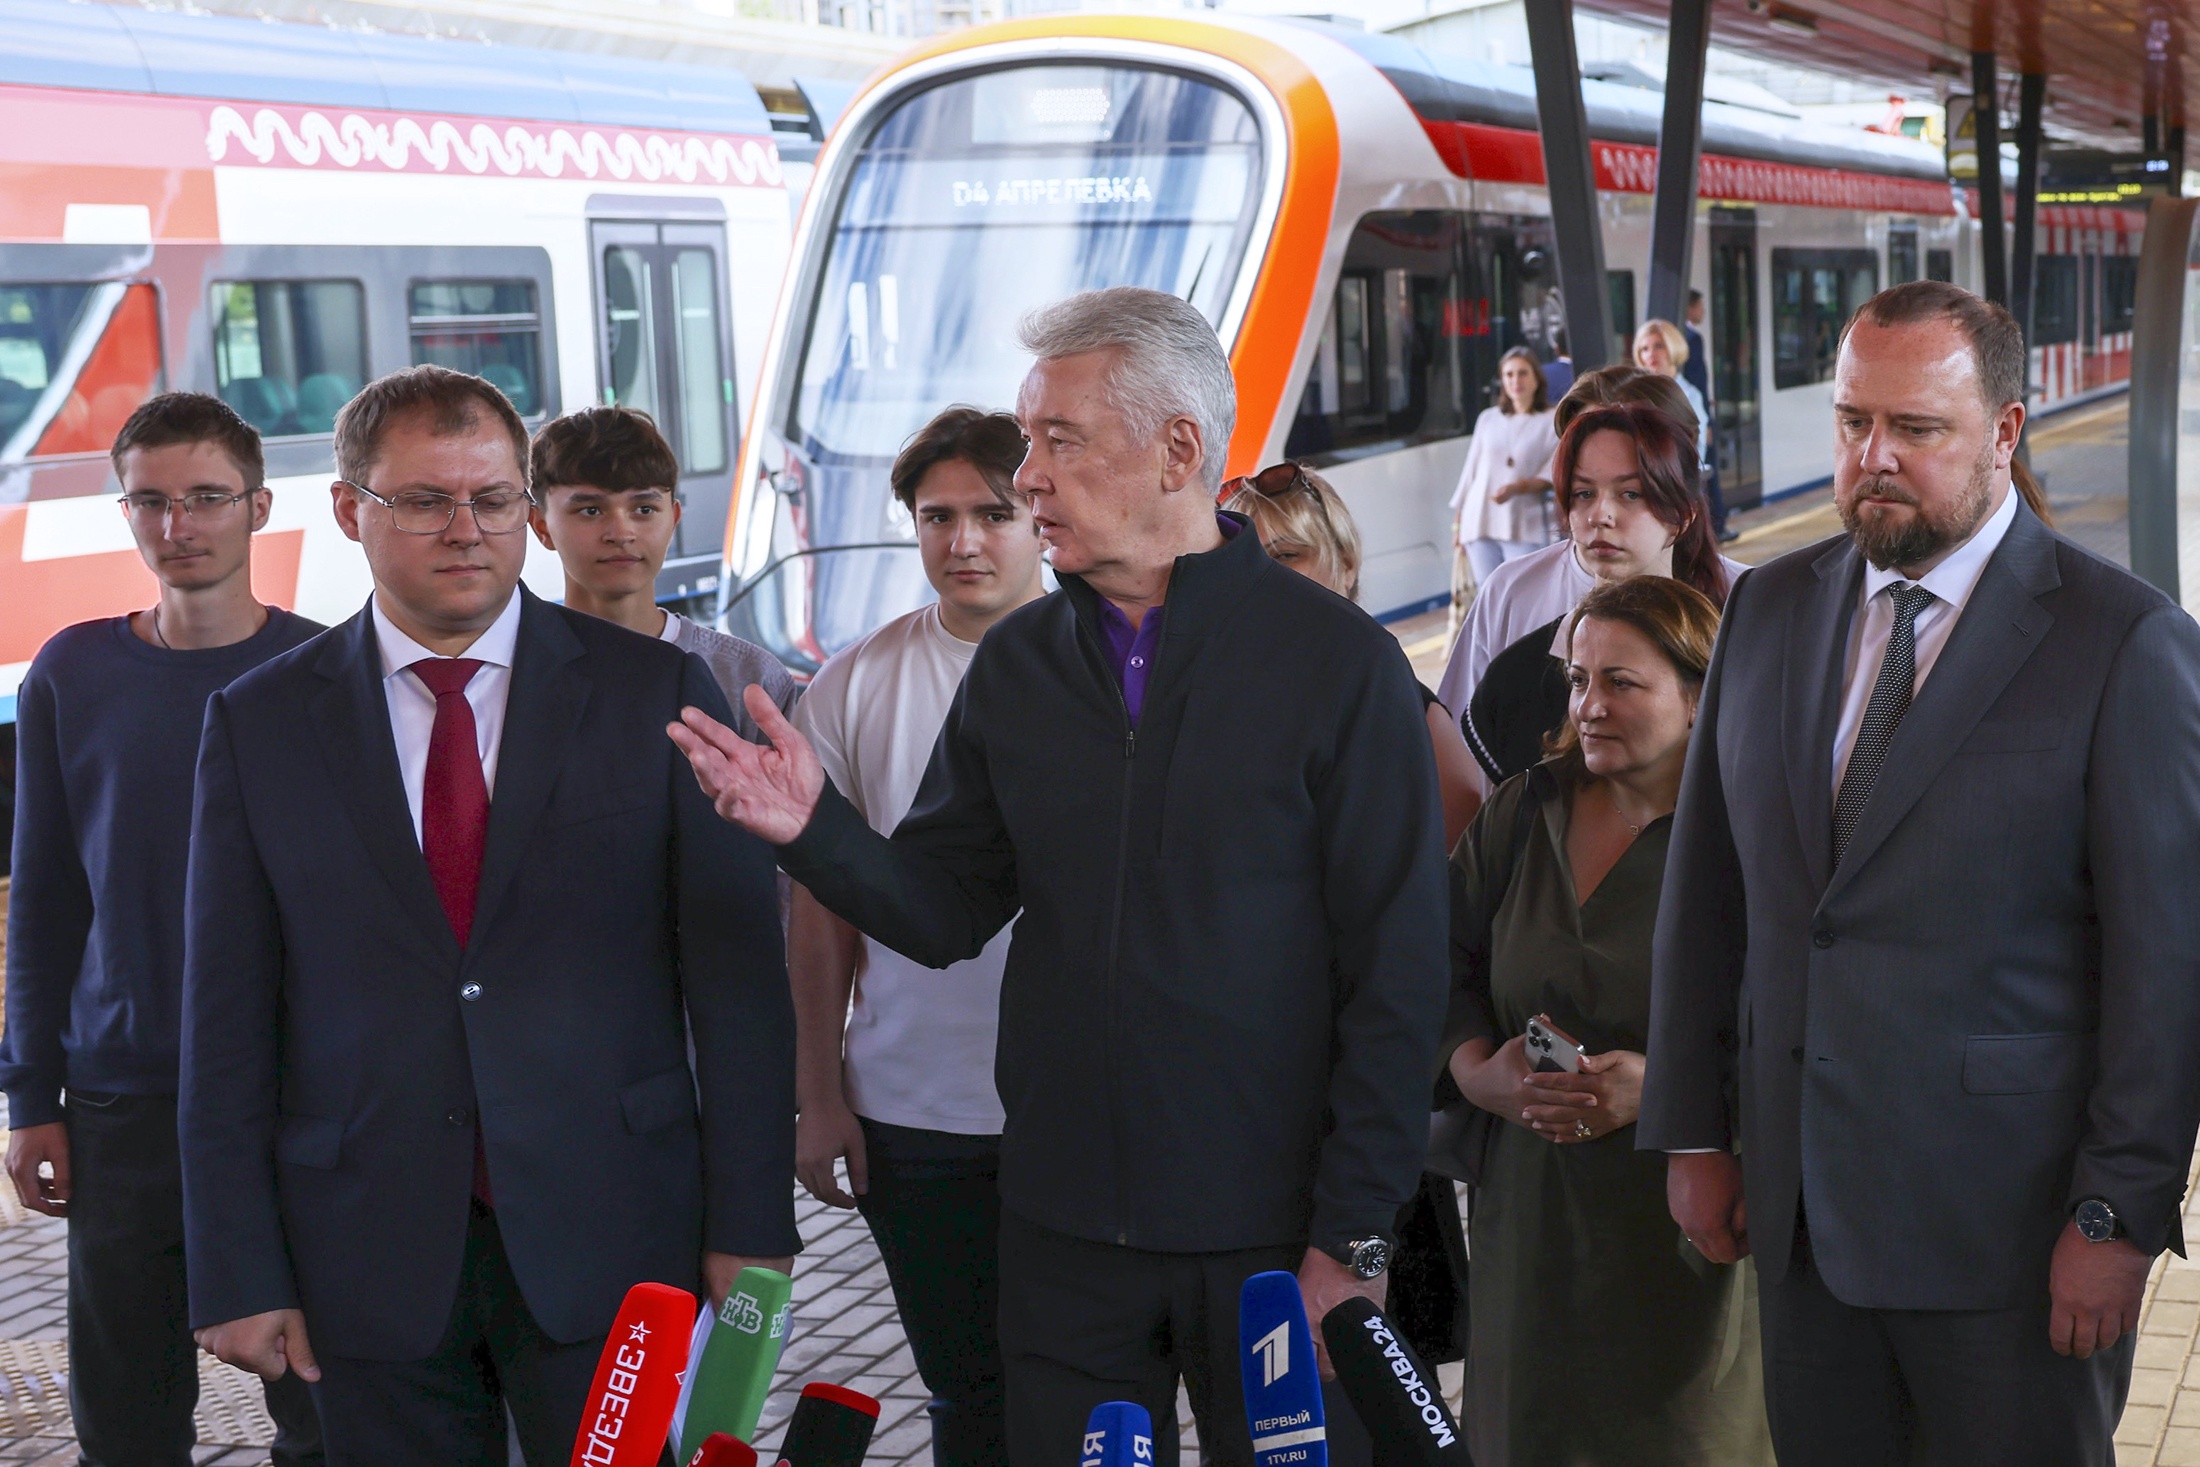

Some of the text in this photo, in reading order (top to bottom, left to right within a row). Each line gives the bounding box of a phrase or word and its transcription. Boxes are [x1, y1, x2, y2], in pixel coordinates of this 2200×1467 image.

[720, 1291, 763, 1334] НТВ
[581, 1344, 646, 1467] ЗВЕЗД
[1255, 1410, 1311, 1432] ПЕРВЫЙ
[1267, 1450, 1307, 1465] 1TV.RU
